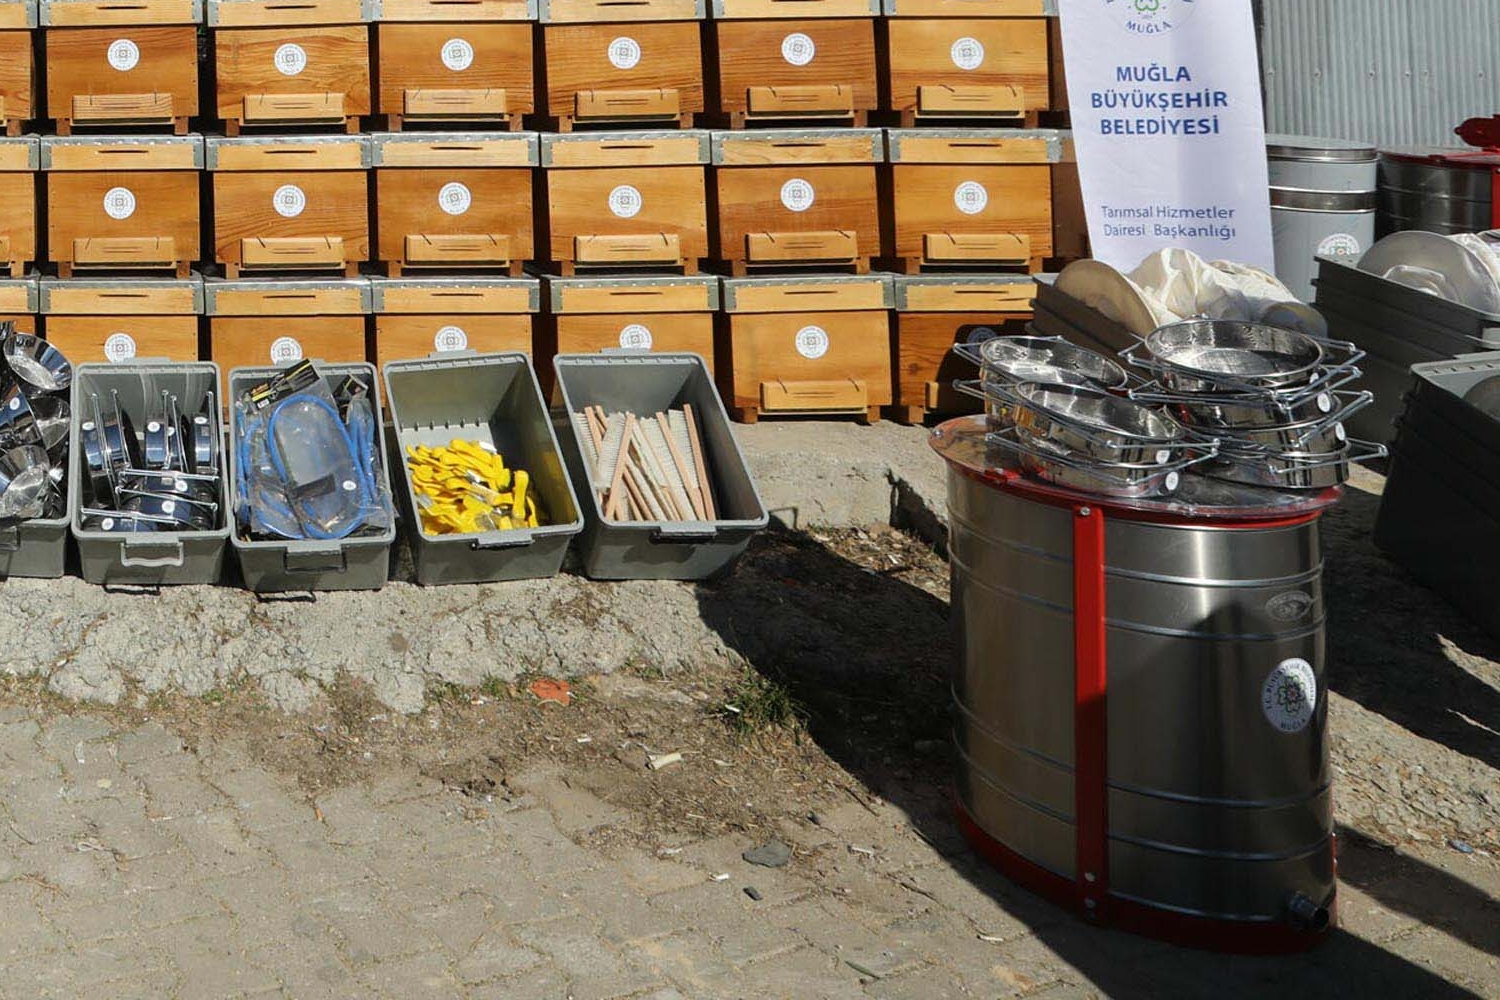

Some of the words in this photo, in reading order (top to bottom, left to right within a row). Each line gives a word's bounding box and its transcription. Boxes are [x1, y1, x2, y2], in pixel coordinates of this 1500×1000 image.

[1126, 20, 1173, 34] MUĞLA
[1116, 61, 1192, 82] MUĞLA
[1091, 87, 1229, 113] BÜYÜKŞEHİR
[1101, 114, 1220, 135] BELEDİYESİ
[1101, 205, 1153, 219] Tarımsal
[1156, 205, 1236, 219] Hizmetler
[1103, 223, 1146, 237] Dairesi
[1153, 223, 1237, 241] Başkanlığı
